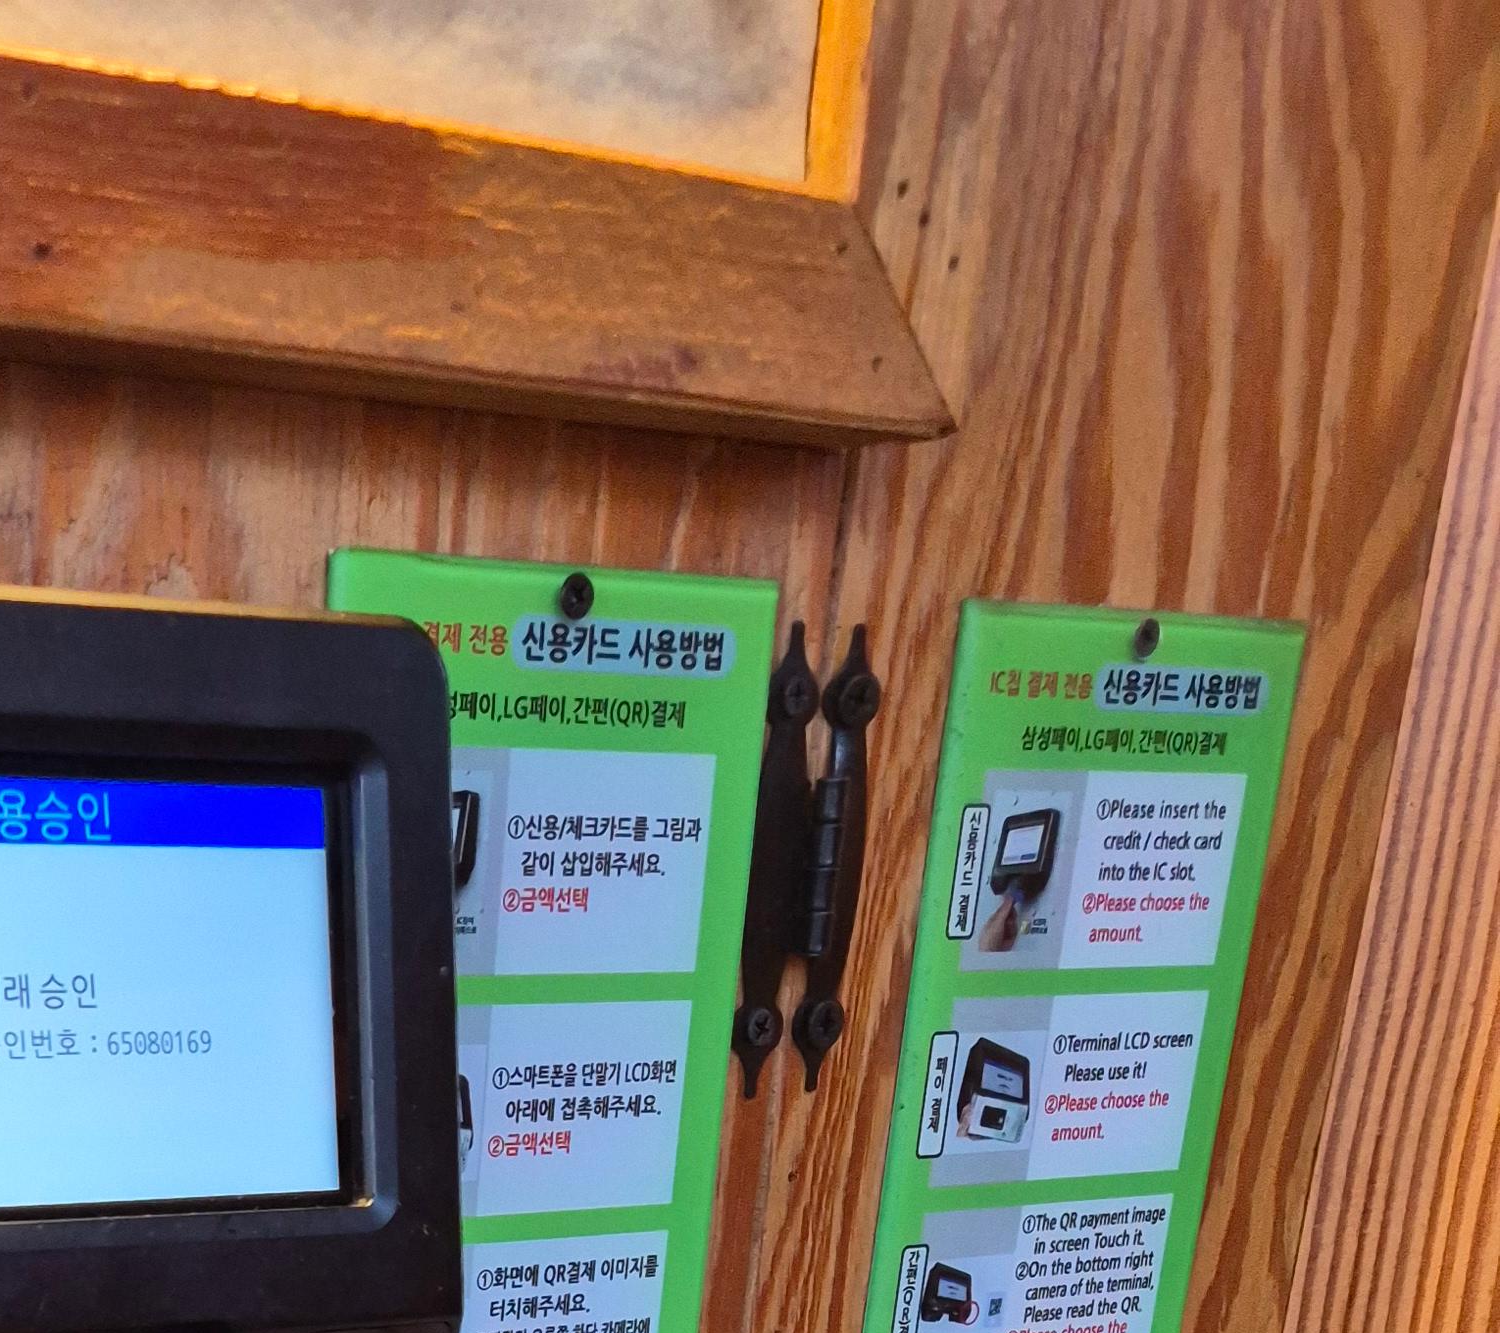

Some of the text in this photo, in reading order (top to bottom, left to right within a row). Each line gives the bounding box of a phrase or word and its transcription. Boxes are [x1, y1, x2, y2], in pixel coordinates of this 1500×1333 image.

[469, 624, 508, 657] 전용
[521, 621, 621, 665] 신용카드
[628, 628, 725, 672] 사용방법
[1028, 671, 1058, 698] 결제
[1064, 673, 1092, 700] 전용
[1104, 669, 1180, 705] 신용카드
[1185, 672, 1261, 709] 사용방법
[1160, 800, 1200, 819] insert
[1204, 800, 1226, 819] the
[652, 817, 702, 843] 그림과
[1104, 830, 1141, 850] credit
[1154, 830, 1191, 850] check
[1194, 831, 1222, 850] card
[521, 851, 666, 877] 같이 삽입해주세요.
[1098, 861, 1196, 881] into the IC slot.
[1140, 892, 1185, 911] choose
[1189, 892, 1209, 910] the
[1089, 925, 1143, 942] amount.
[40, 973, 97, 1010] 승인
[107, 1030, 212, 1055] 65080169
[1124, 1032, 1150, 1050] LCD
[1153, 1033, 1193, 1048] screen
[582, 1061, 621, 1087] 단말기
[625, 1059, 677, 1084] LCD화면
[1065, 1061, 1147, 1082] Please use it!
[506, 1094, 662, 1123] 아래에 접촉해주세요.
[1101, 1090, 1145, 1109] choose
[1149, 1088, 1169, 1106] the
[1051, 1122, 1104, 1141] amount.
[1060, 1212, 1077, 1233] QR
[1080, 1208, 1129, 1230] payment
[1132, 1206, 1166, 1225] image
[1034, 1237, 1045, 1254] in
[1049, 1235, 1089, 1253] screen
[1094, 1229, 1129, 1249] Touch
[544, 1259, 596, 1286] QR결제
[600, 1254, 659, 1280] 이미지를
[1052, 1258, 1070, 1274] the
[1075, 1256, 1120, 1273] bottom
[1125, 1250, 1154, 1270] right
[1025, 1284, 1066, 1300] camera
[1070, 1278, 1084, 1296] of
[1085, 1278, 1104, 1294] the
[490, 1293, 591, 1322] 터치해주세요.
[1023, 1305, 1062, 1324] Please
[1067, 1300, 1094, 1319] read
[1098, 1297, 1117, 1314] the
